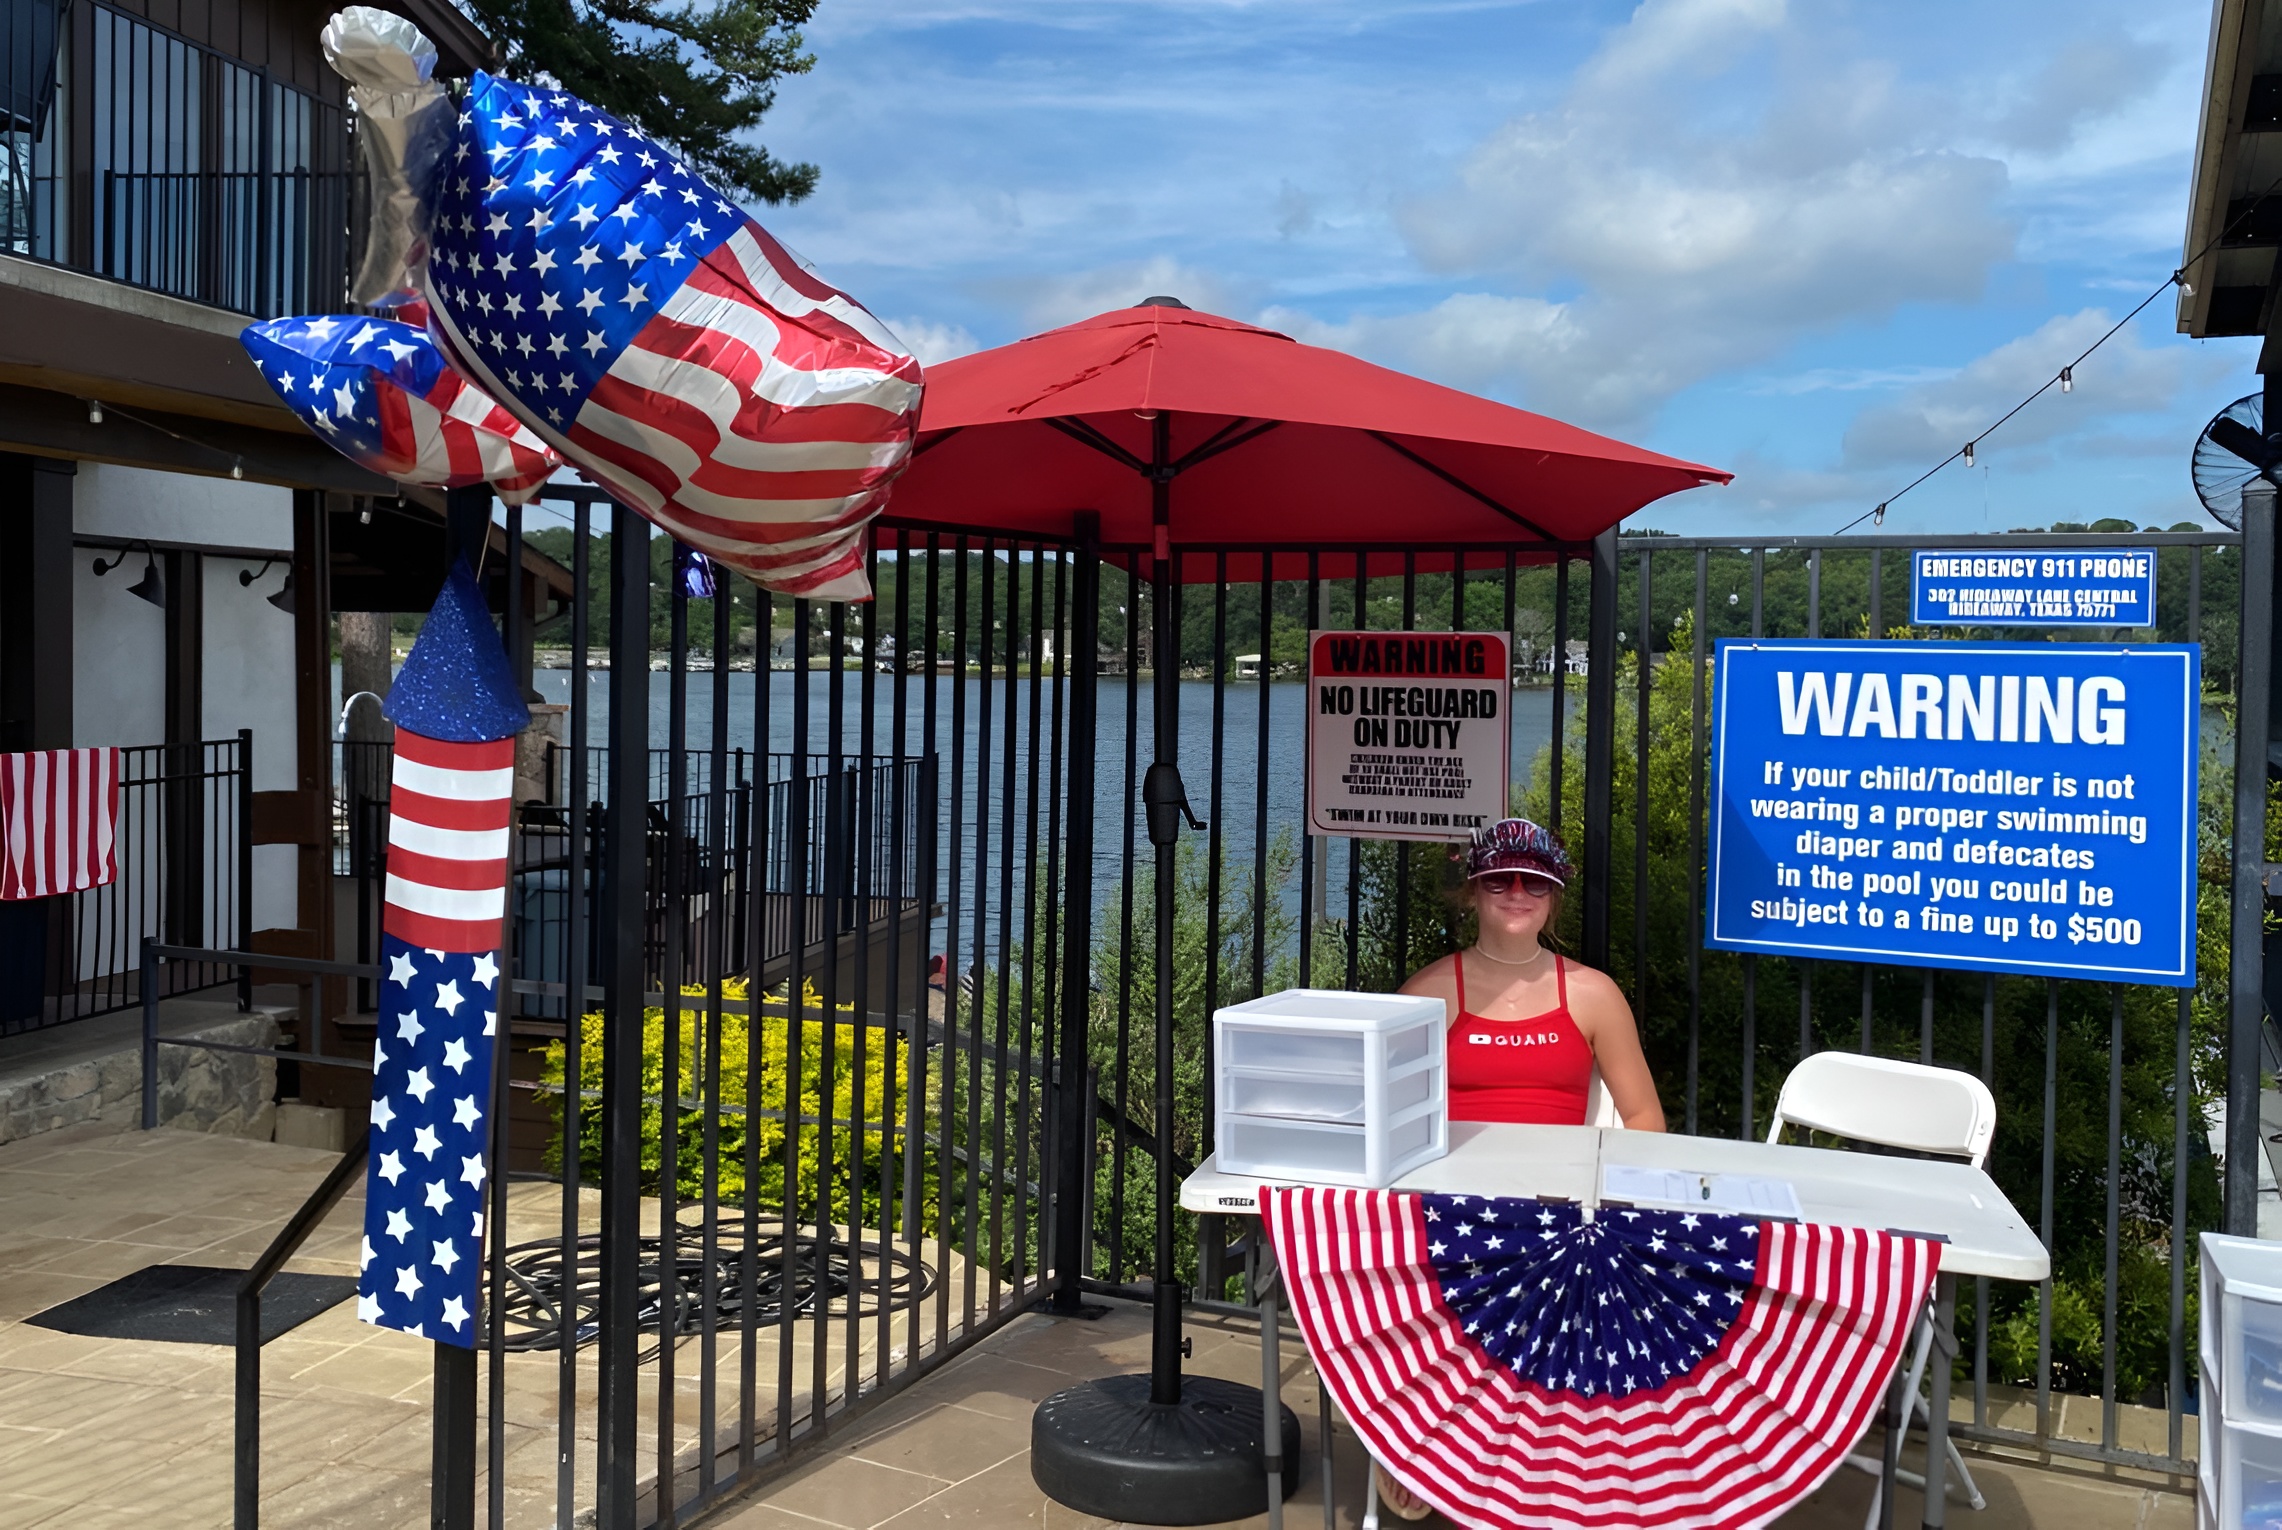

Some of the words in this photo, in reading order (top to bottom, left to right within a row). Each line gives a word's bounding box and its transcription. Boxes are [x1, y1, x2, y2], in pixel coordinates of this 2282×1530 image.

[1922, 558, 2037, 578] EMERGENCY
[2042, 558, 2075, 578] 911
[2080, 558, 2148, 579] PHONE
[1330, 639, 1486, 674] WARNING
[1320, 685, 1354, 715] NO
[1360, 686, 1497, 719] LIFEGUARD
[1777, 671, 2126, 745] WARNING
[1354, 718, 1388, 747] ON
[1394, 719, 1461, 750] DUTY
[1764, 760, 1784, 785] If
[1790, 767, 1852, 792] your
[1859, 765, 2044, 796] child/Toddler
[2053, 771, 2078, 798] is
[2087, 774, 2135, 800] not
[1750, 796, 1859, 830] wearing
[1869, 804, 1885, 824] a
[1895, 806, 1989, 833] proper
[1997, 806, 2147, 844] swimming
[1796, 829, 1884, 862] diaper
[1891, 836, 1943, 862] and
[1953, 838, 2095, 870] defecates
[1777, 862, 1801, 887] in
[1809, 864, 1854, 891] the
[1863, 870, 1921, 898] pool
[1929, 877, 1979, 903] you
[1990, 877, 2068, 904] could
[2078, 880, 2114, 907] be
[1750, 896, 1849, 928] subject
[1857, 901, 1884, 928] to
[1894, 909, 1910, 930] a
[1919, 905, 1974, 934] fine
[1984, 915, 2019, 943] up
[2028, 913, 2057, 940] to
[2067, 912, 2142, 945] $500
[1494, 1032, 1560, 1047] GUARD
